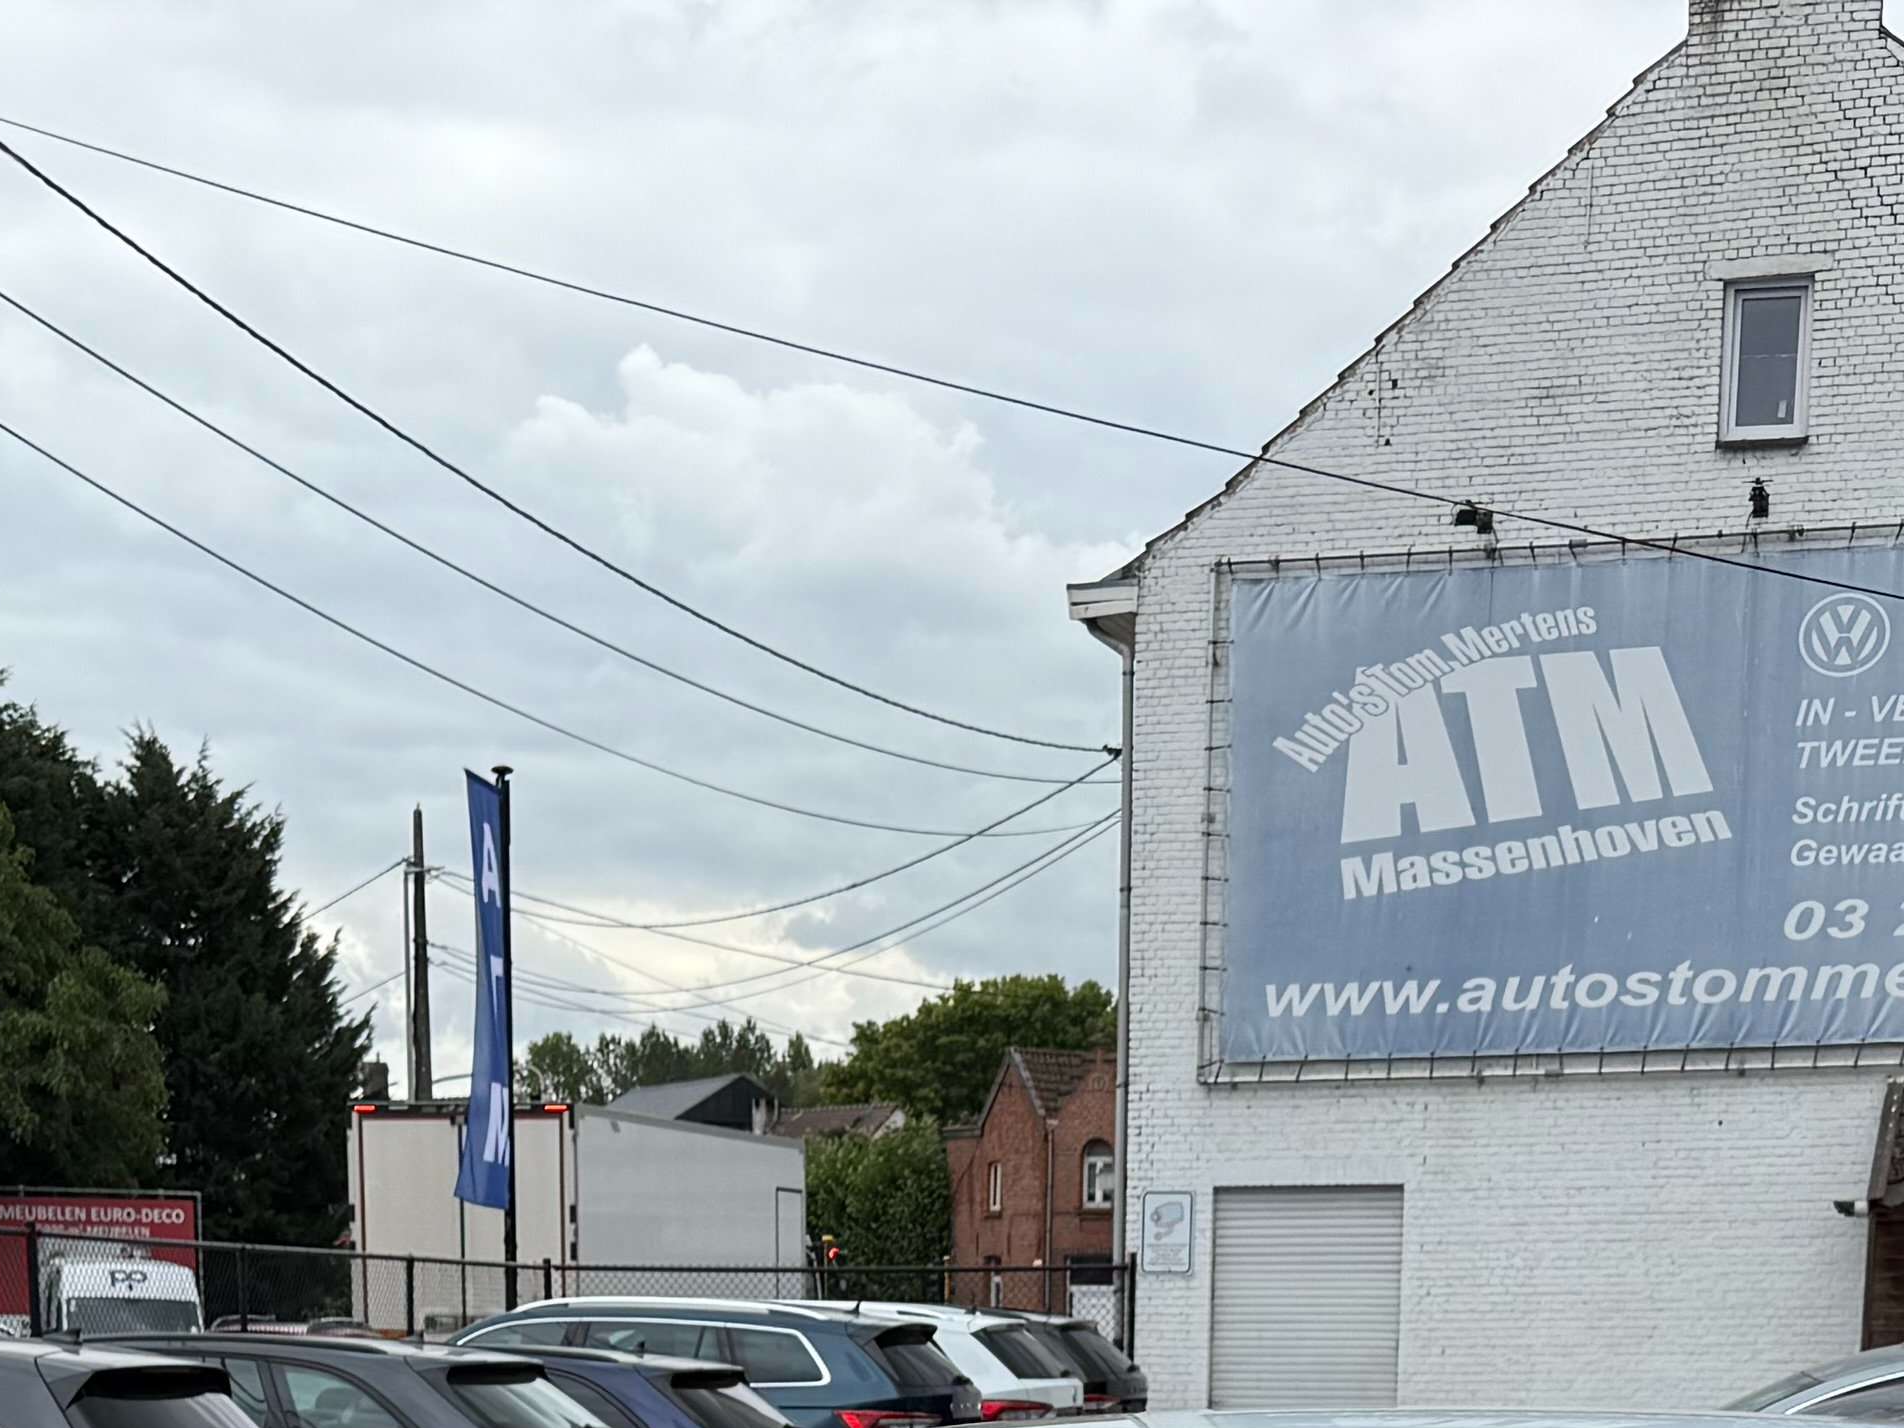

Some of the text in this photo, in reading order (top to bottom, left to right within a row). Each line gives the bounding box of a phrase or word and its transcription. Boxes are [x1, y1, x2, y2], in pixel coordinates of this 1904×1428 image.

[1272, 604, 1599, 773] Auto's Tom Mertens
[1795, 697, 1835, 728] IN
[1341, 646, 1714, 844] ATM
[1341, 809, 1733, 900] Massenhoven
[1783, 898, 1867, 941] 03
[90, 1205, 186, 1225] EURO-DECO
